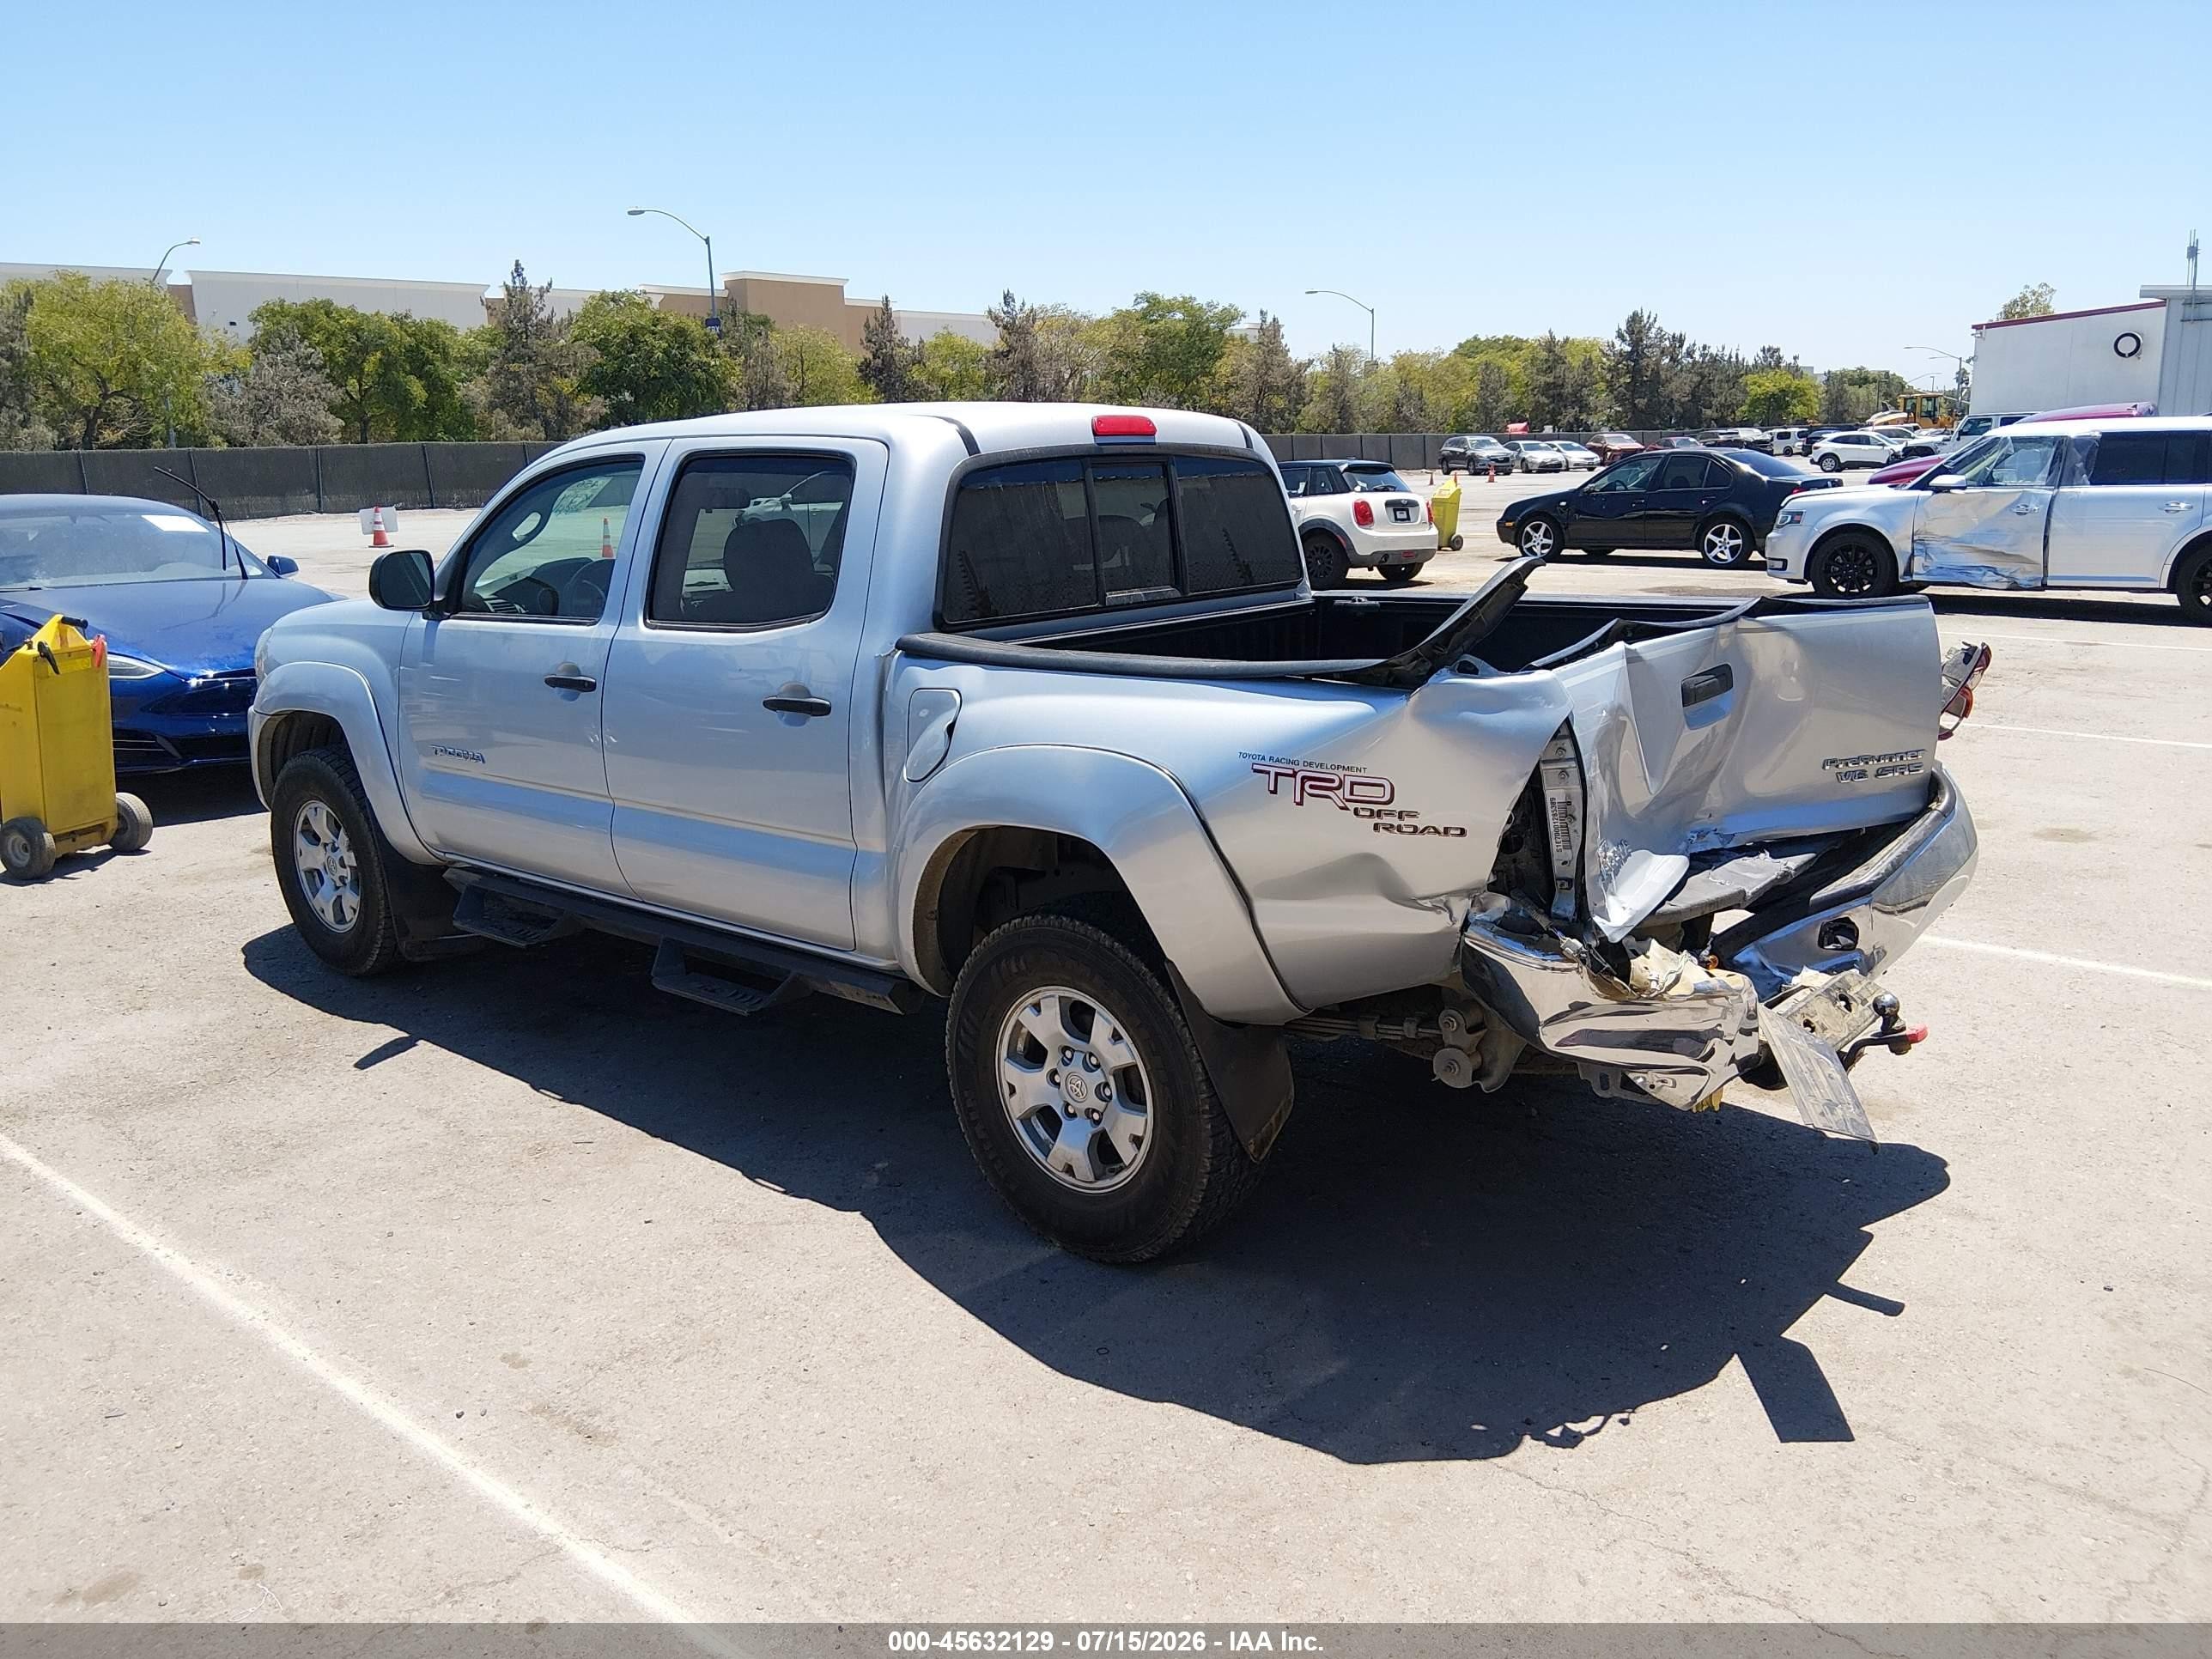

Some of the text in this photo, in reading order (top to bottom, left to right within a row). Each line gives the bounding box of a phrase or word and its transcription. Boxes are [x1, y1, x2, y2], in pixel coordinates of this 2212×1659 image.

[1238, 751, 1367, 774] TOYOTA RACING DEVELOPMENT
[1822, 748, 1927, 770] PreRunner
[1836, 762, 1924, 783] V6 SR5
[1251, 763, 1395, 811] TRD
[1352, 807, 1421, 820] OFF
[1372, 822, 1468, 837] ROAD
